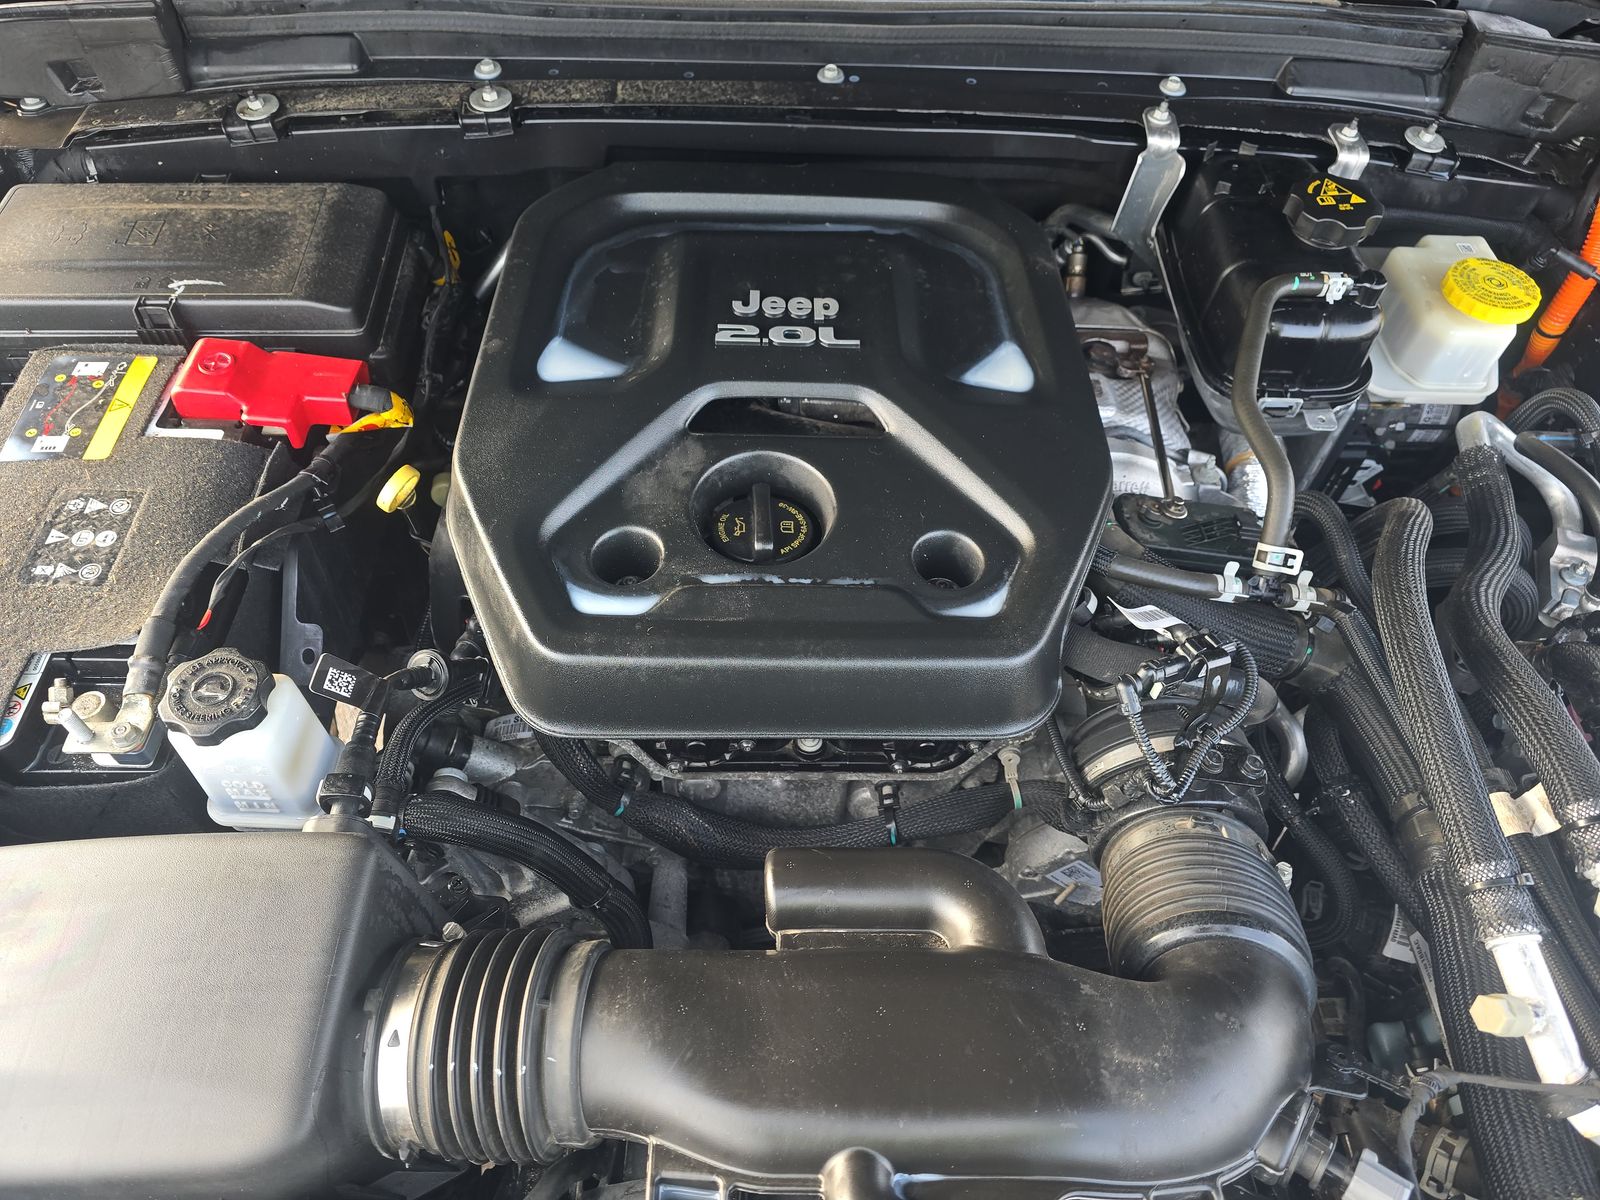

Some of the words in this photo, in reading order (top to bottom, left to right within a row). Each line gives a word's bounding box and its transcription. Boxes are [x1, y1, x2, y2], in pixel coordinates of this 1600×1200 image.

[732, 290, 839, 322] Jeep
[715, 324, 860, 348] 2.0L
[1112, 480, 1150, 494] arrett
[720, 513, 730, 523] OIL
[718, 522, 730, 543] ENGINE
[780, 545, 793, 555] API
[206, 656, 251, 675] APPROVED
[185, 705, 233, 721] STEERING
[221, 780, 265, 789] COLD
[225, 788, 271, 797] MAX
[234, 801, 279, 809] MIN
